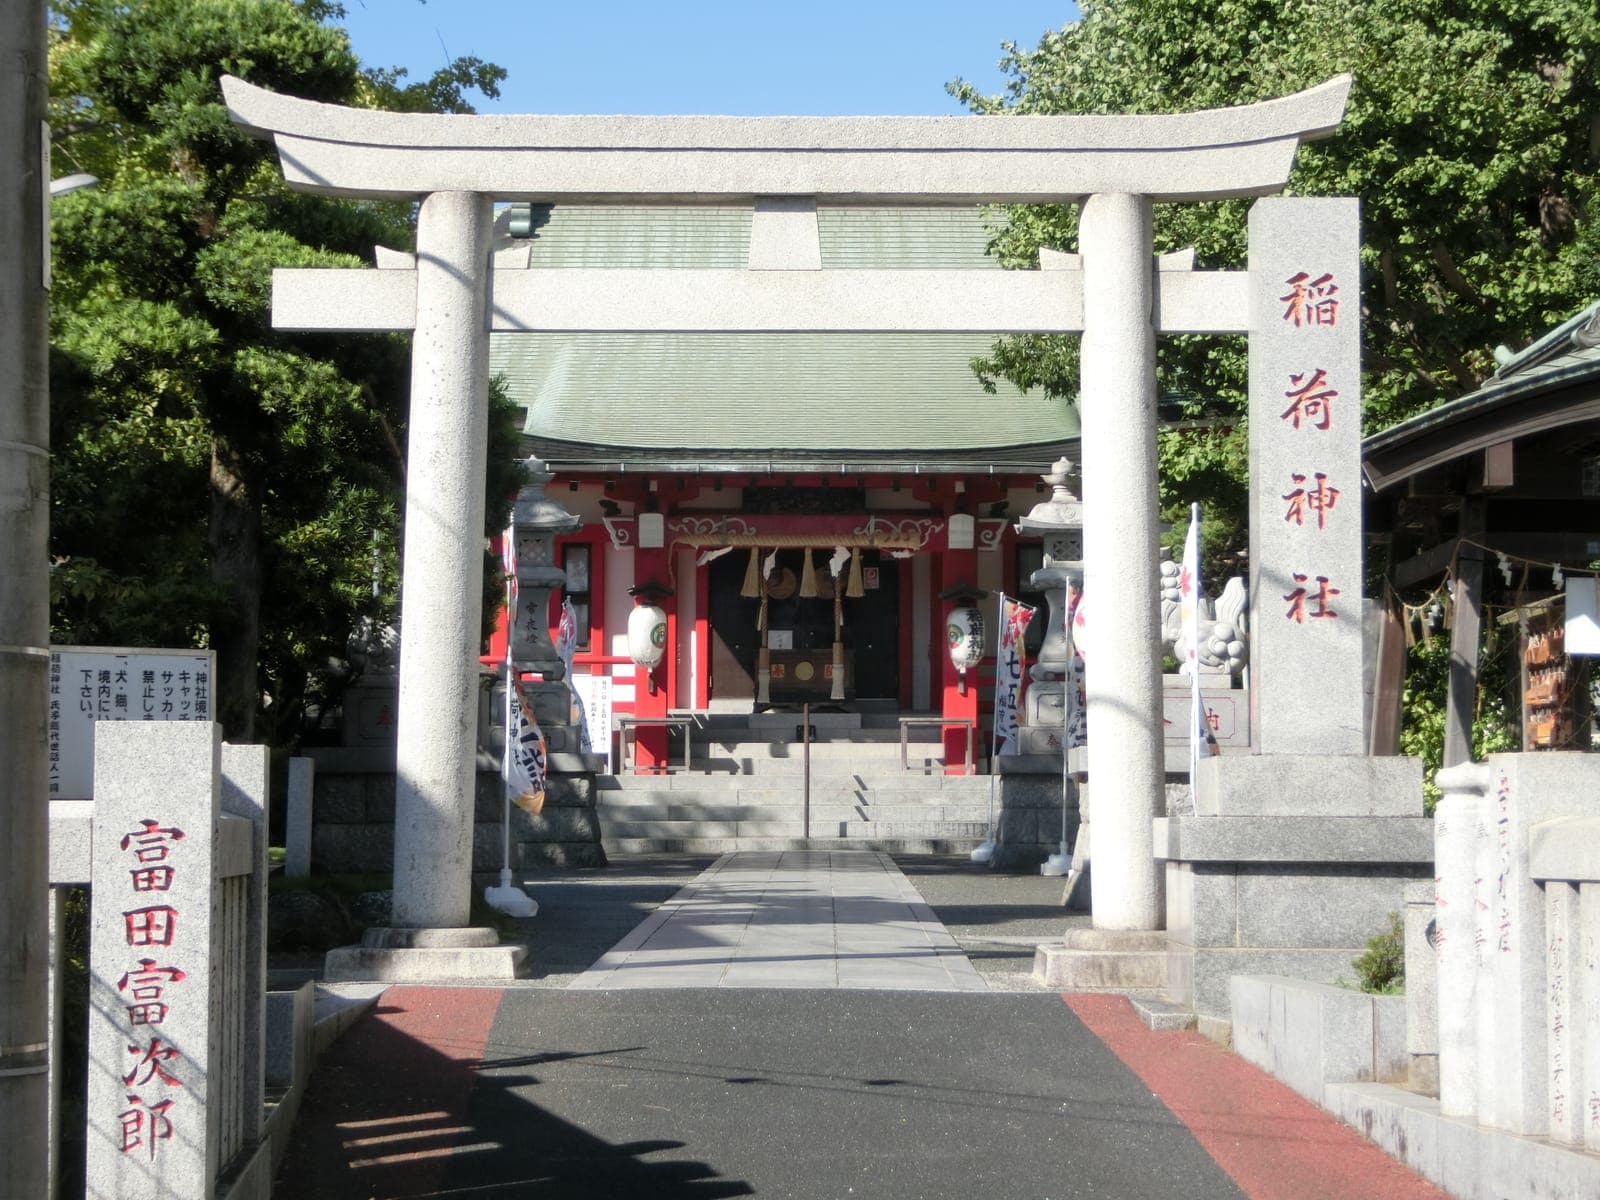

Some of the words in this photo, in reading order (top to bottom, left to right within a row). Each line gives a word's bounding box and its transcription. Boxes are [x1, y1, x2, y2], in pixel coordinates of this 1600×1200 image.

[1279, 272, 1342, 624] 稲荷神社
[80, 670, 94, 720] 下さい。
[115, 655, 128, 721] 一、犬・猫、
[117, 818, 186, 1161] 富田富次郎
